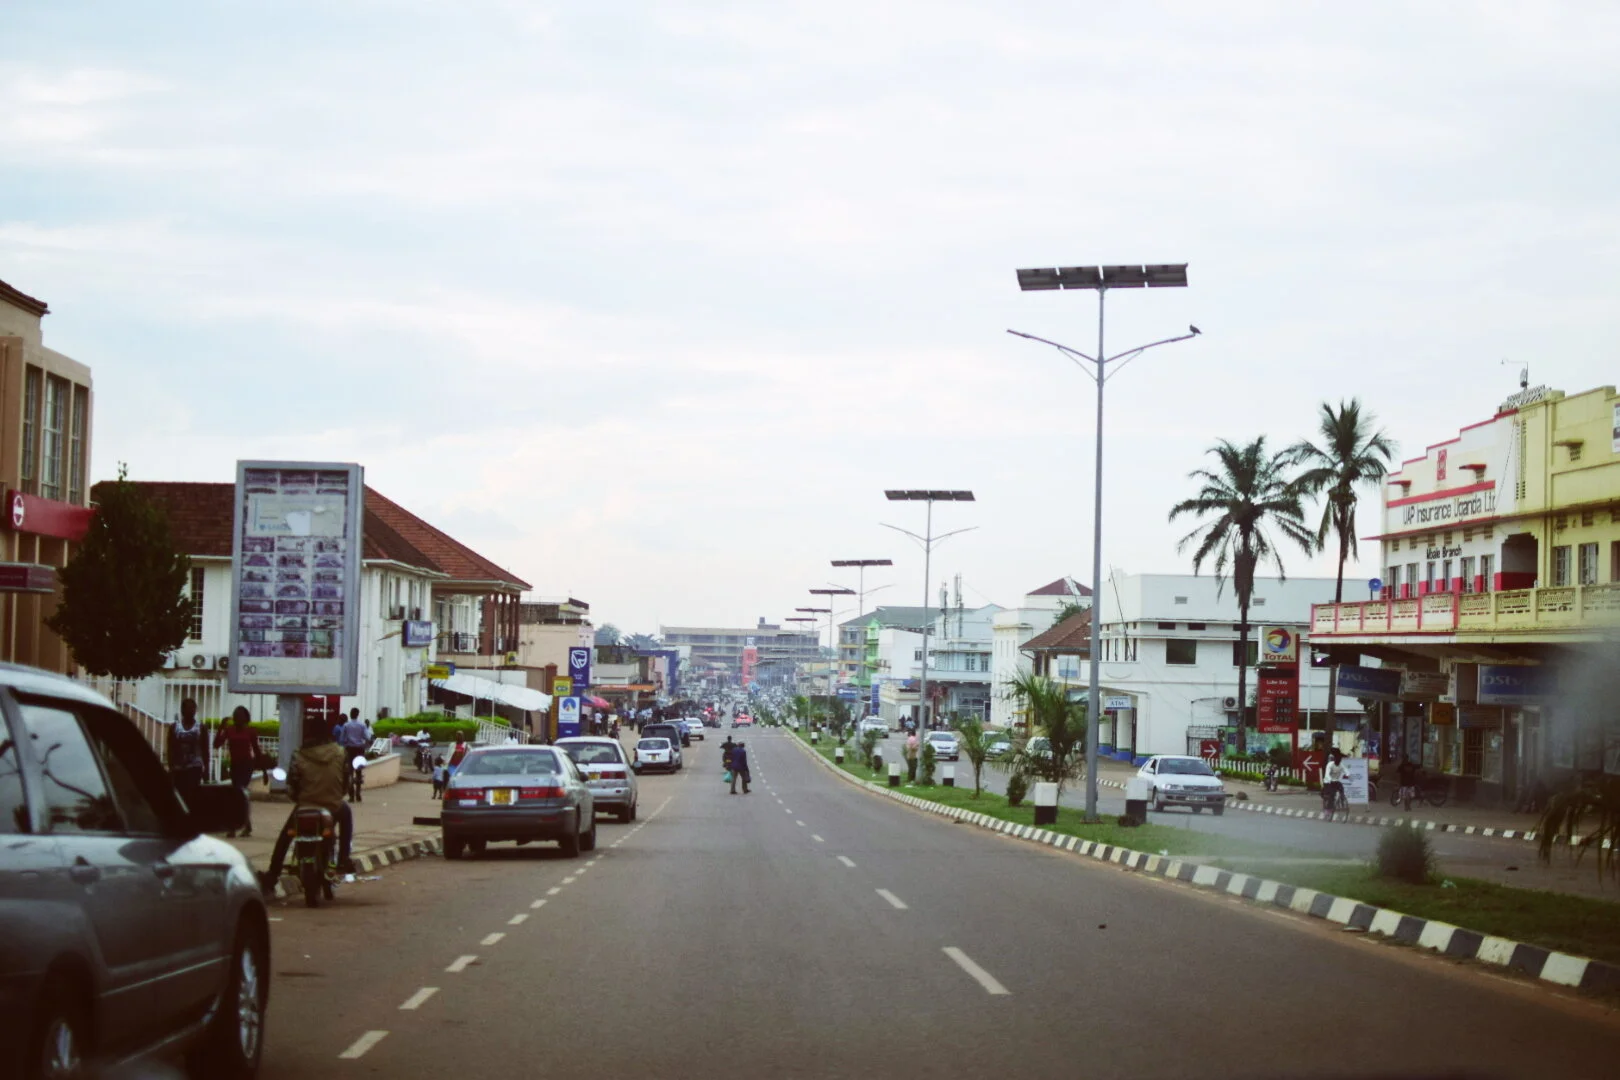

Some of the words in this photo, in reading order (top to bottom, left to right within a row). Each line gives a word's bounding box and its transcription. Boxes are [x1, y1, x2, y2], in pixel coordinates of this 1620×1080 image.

[1402, 505, 1415, 525] UAP
[1417, 502, 1452, 523] Insurance
[1454, 494, 1482, 518] Uganda
[1442, 544, 1462, 558] Branch
[1263, 653, 1295, 662] TOTAL
[242, 664, 257, 676] 90
[1481, 675, 1523, 687] DStv
